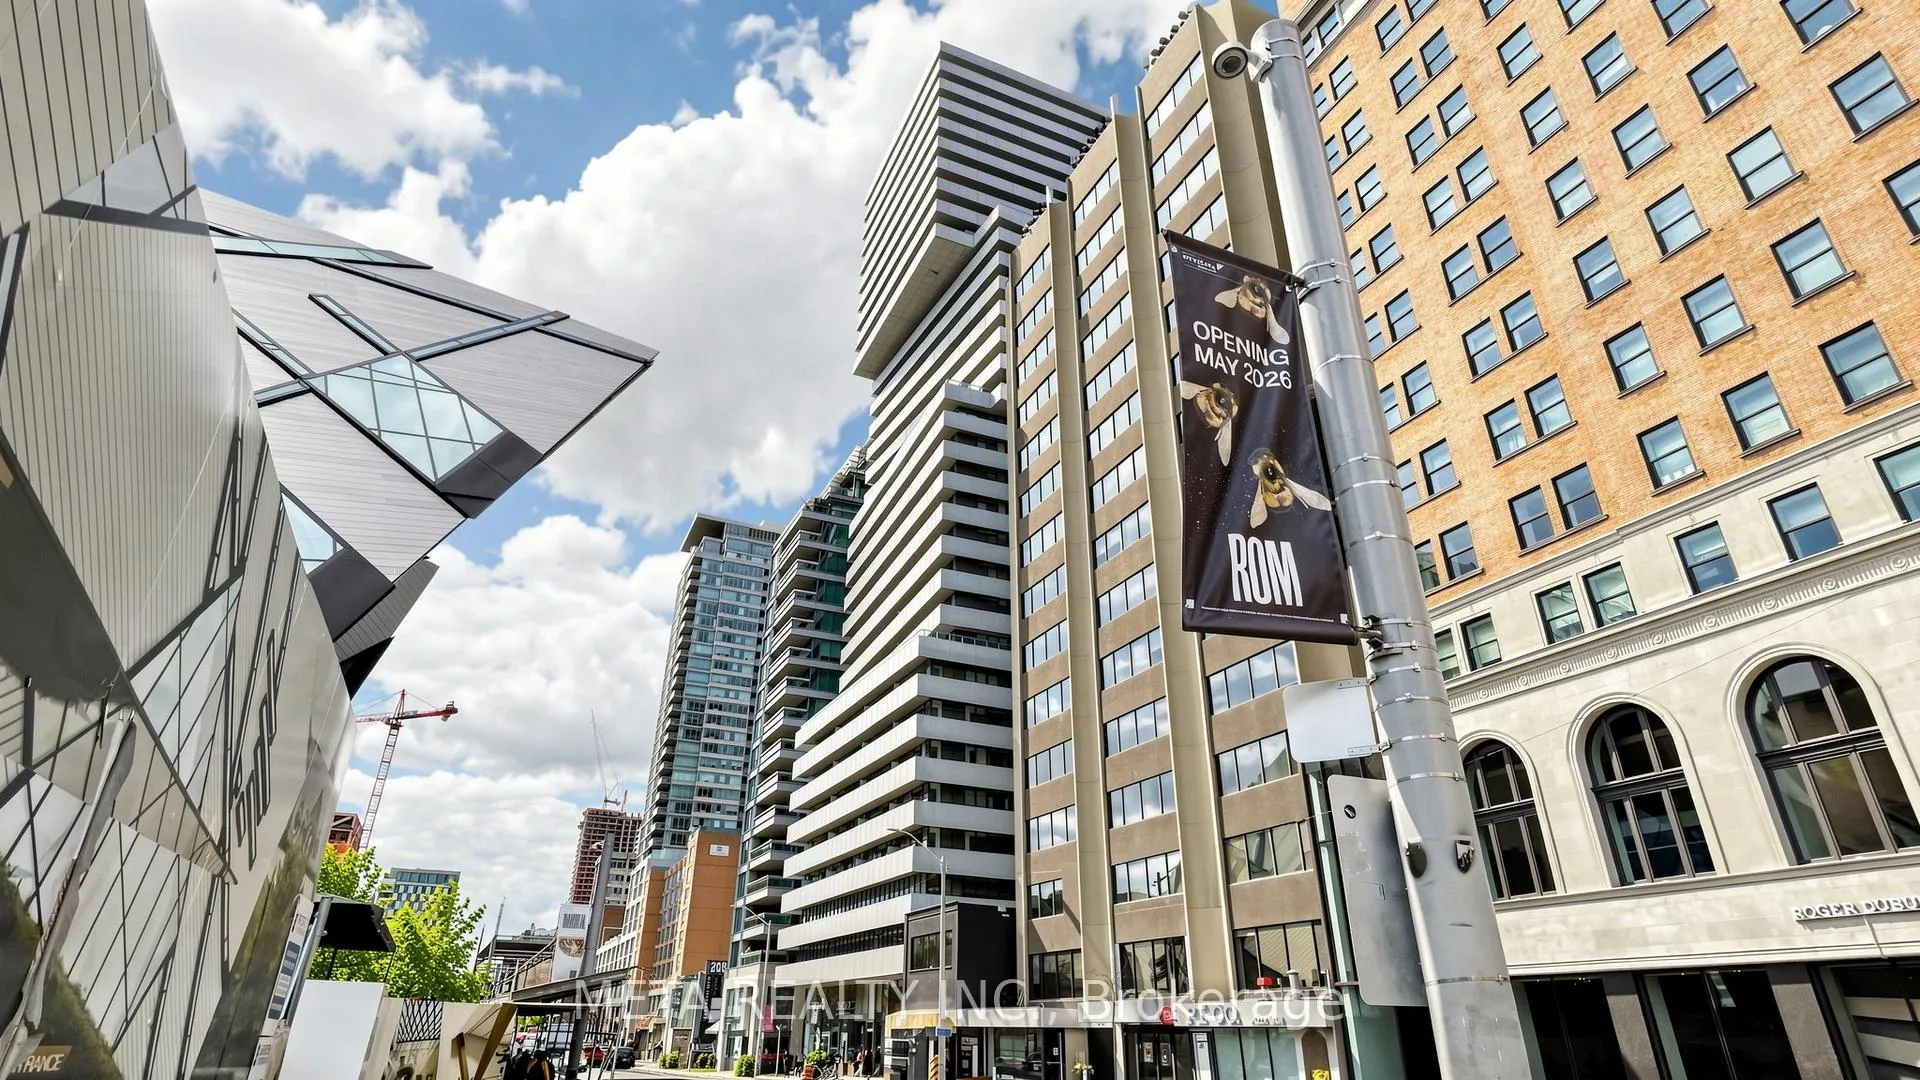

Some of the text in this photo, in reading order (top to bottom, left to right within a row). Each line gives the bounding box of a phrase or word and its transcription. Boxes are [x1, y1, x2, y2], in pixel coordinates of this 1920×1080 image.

[1193, 320, 1290, 367] OPENING
[1194, 342, 1292, 390] MAY 2026
[1227, 533, 1304, 607] ROM
[1791, 903, 1860, 919] ROGER
